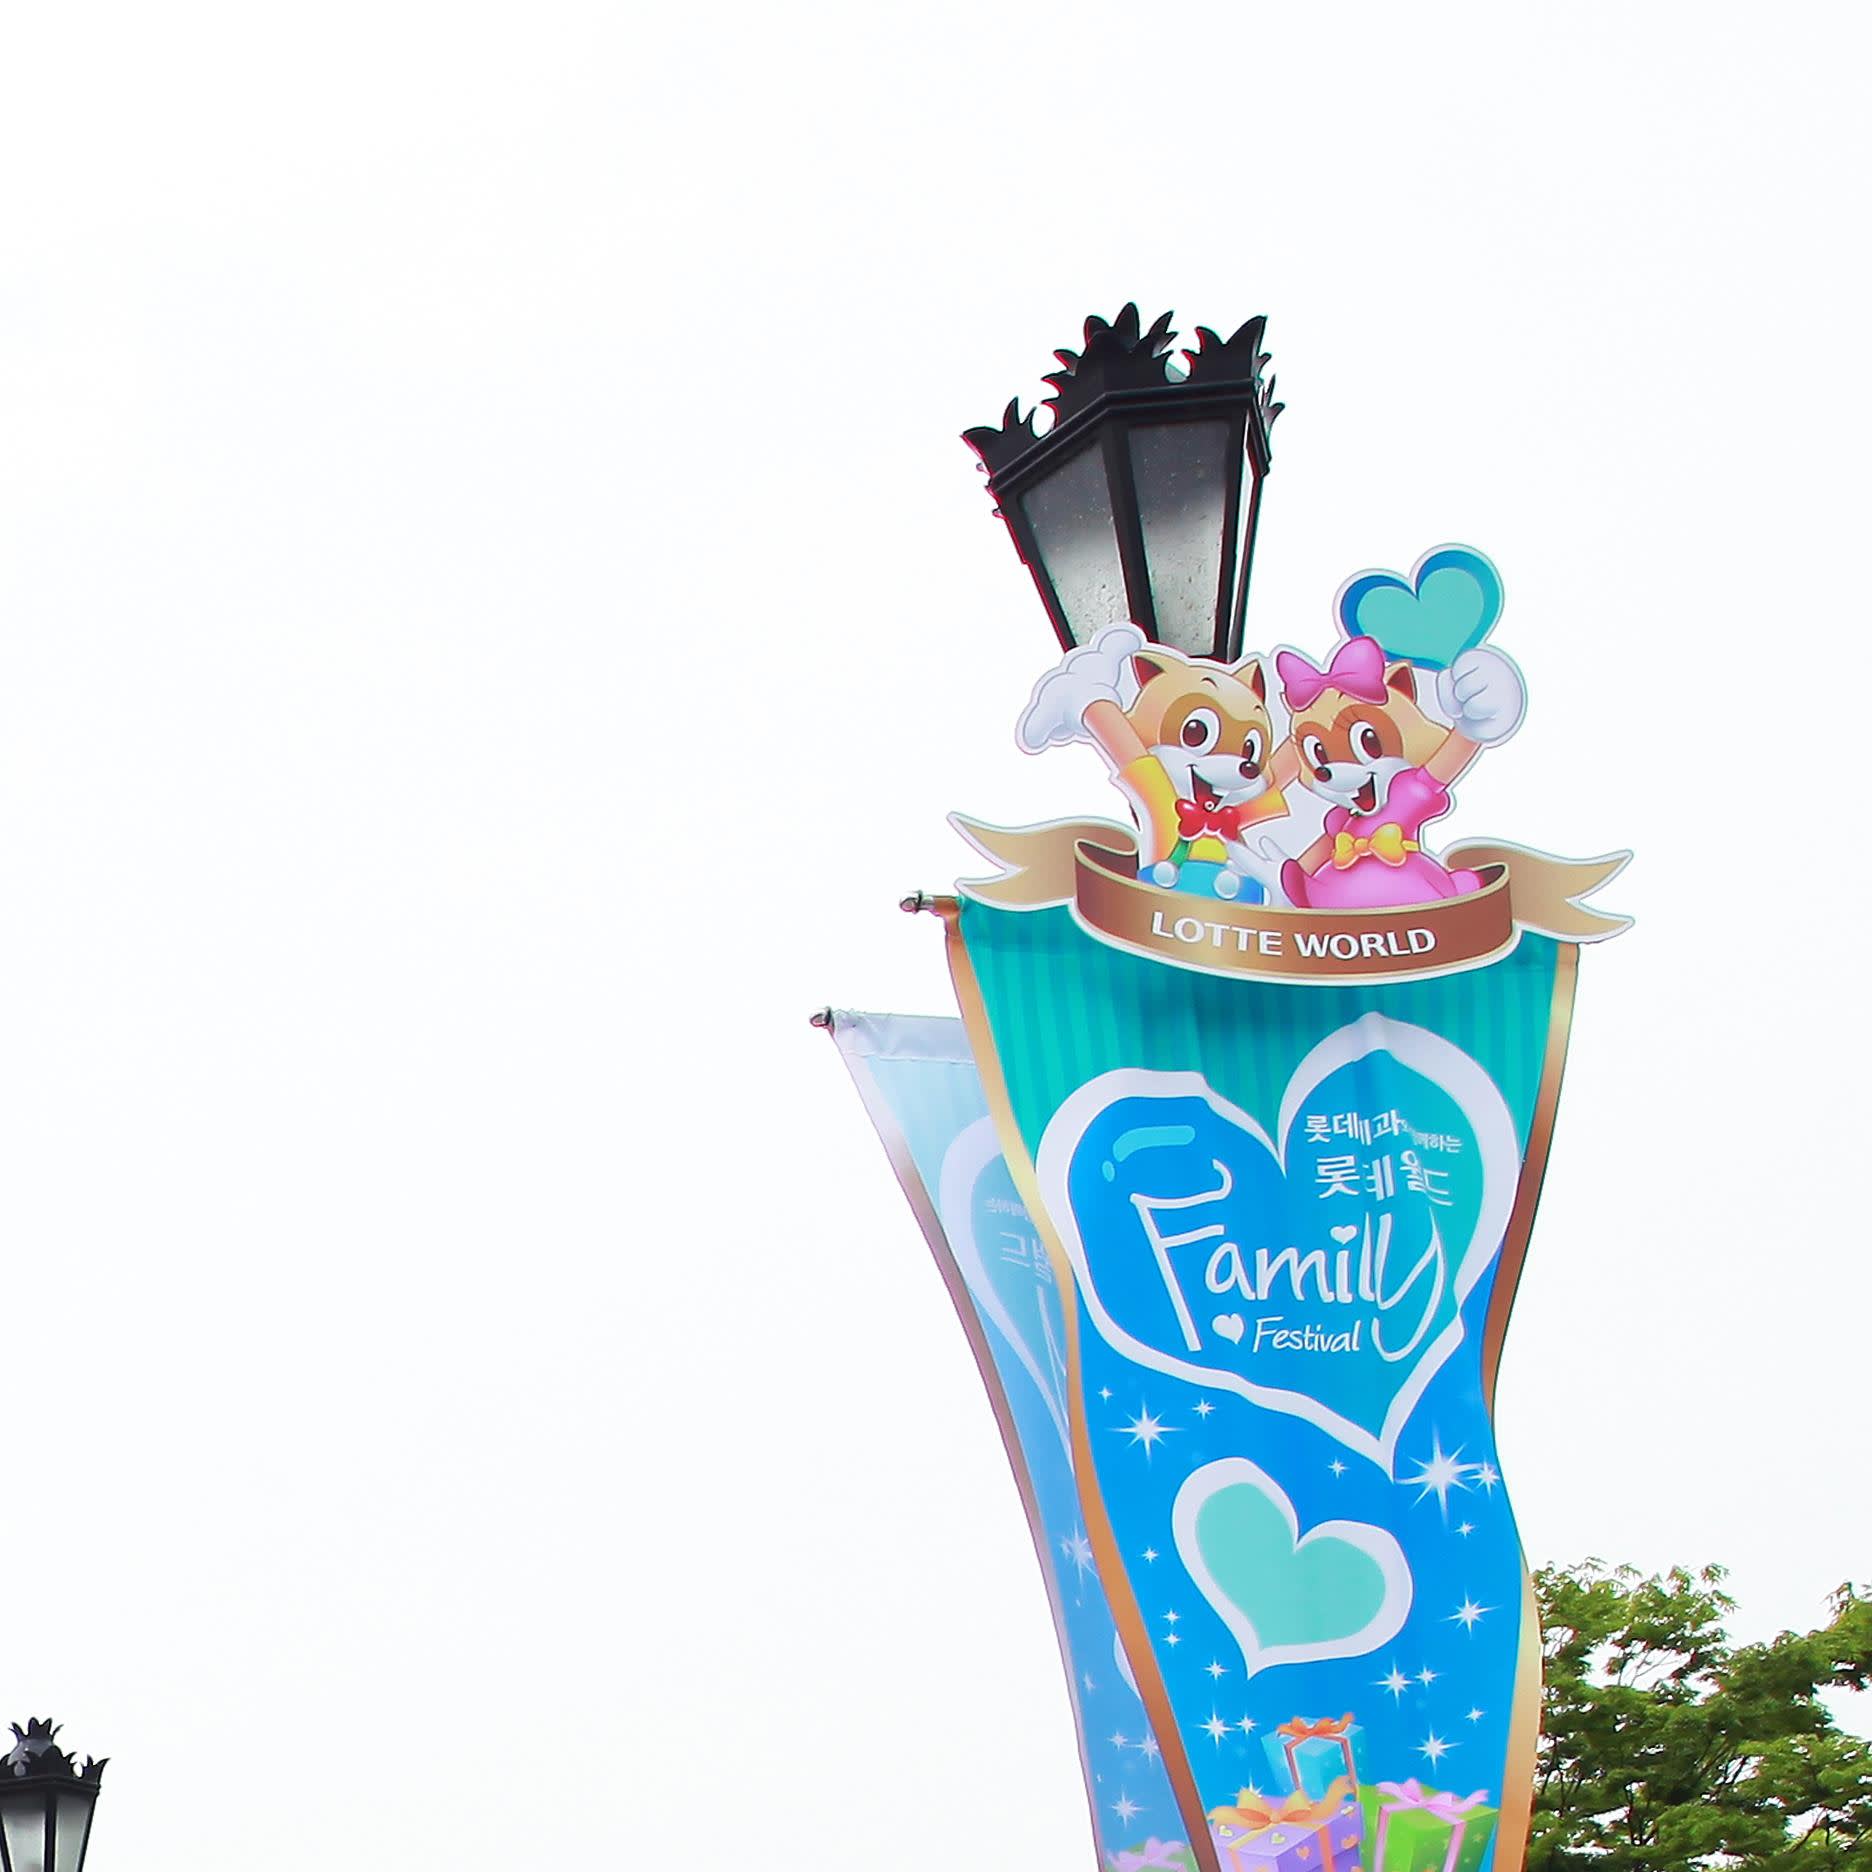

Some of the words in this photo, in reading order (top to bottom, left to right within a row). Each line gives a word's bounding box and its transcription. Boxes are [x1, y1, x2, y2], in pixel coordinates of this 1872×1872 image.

[1151, 911, 1283, 956] LOTTE
[1294, 928, 1437, 960] WORLD
[1129, 1158, 1446, 1363] Family
[1252, 1316, 1361, 1353] Festival
